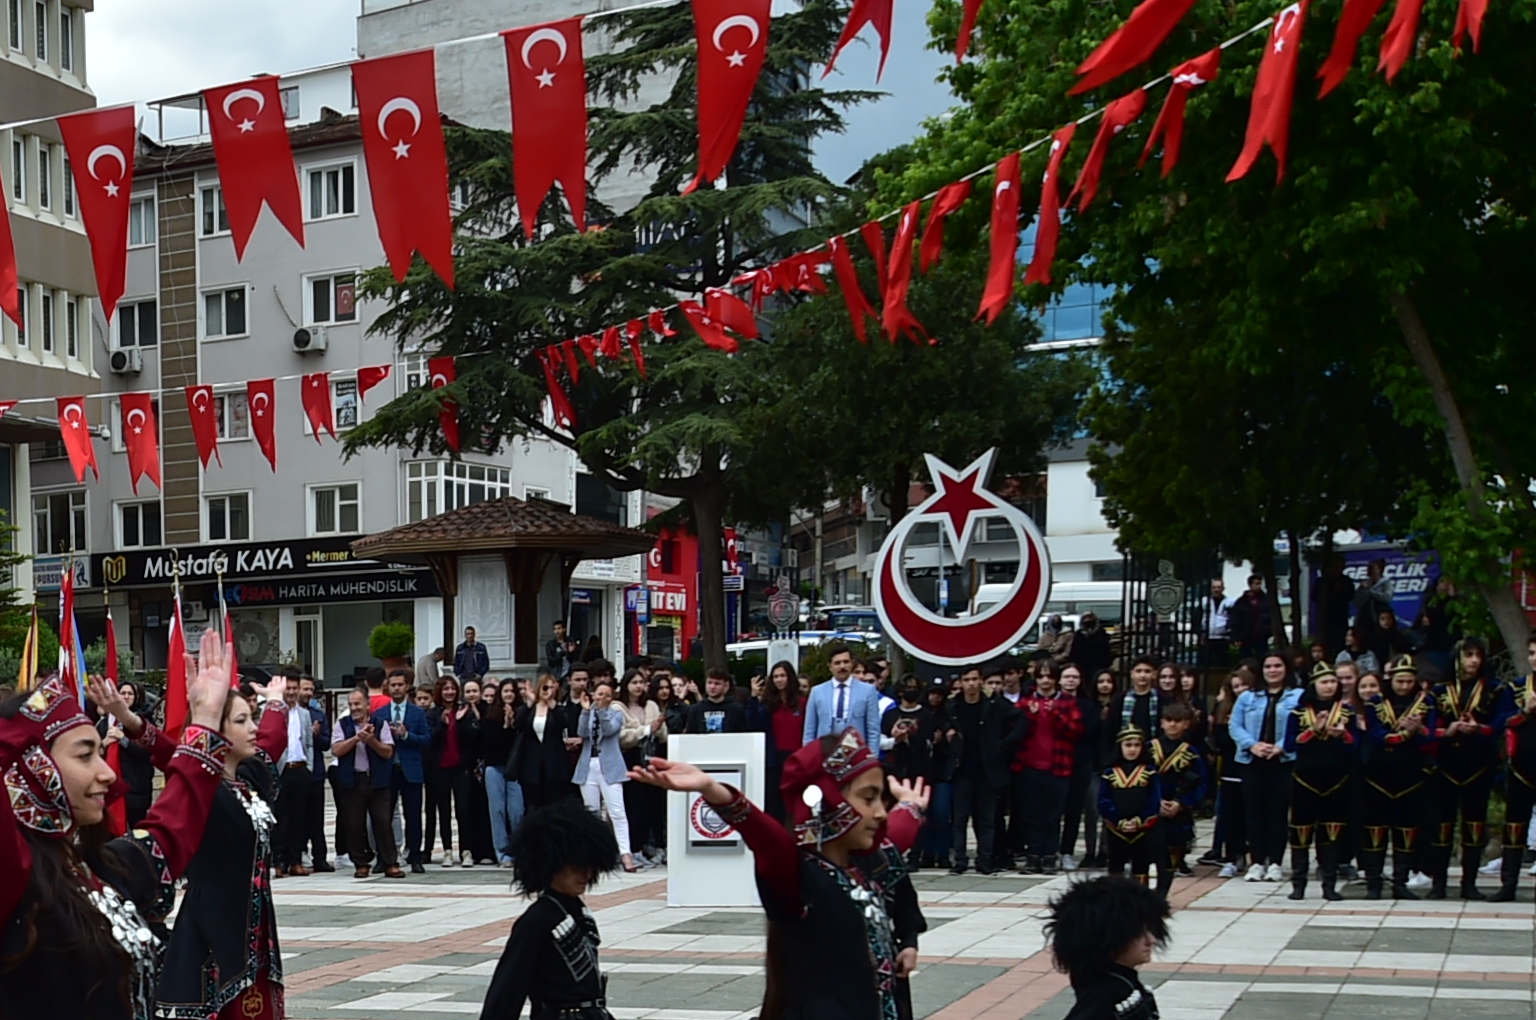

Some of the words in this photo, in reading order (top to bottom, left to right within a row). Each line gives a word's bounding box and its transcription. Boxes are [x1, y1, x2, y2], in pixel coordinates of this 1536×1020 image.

[144, 552, 229, 579] Mustafa
[236, 547, 294, 572] KAYA
[311, 551, 349, 563] Mermer
[279, 584, 326, 599] HARİTA
[330, 578, 418, 596] MÜHENDİSLİK
[665, 588, 686, 612] EVİ
